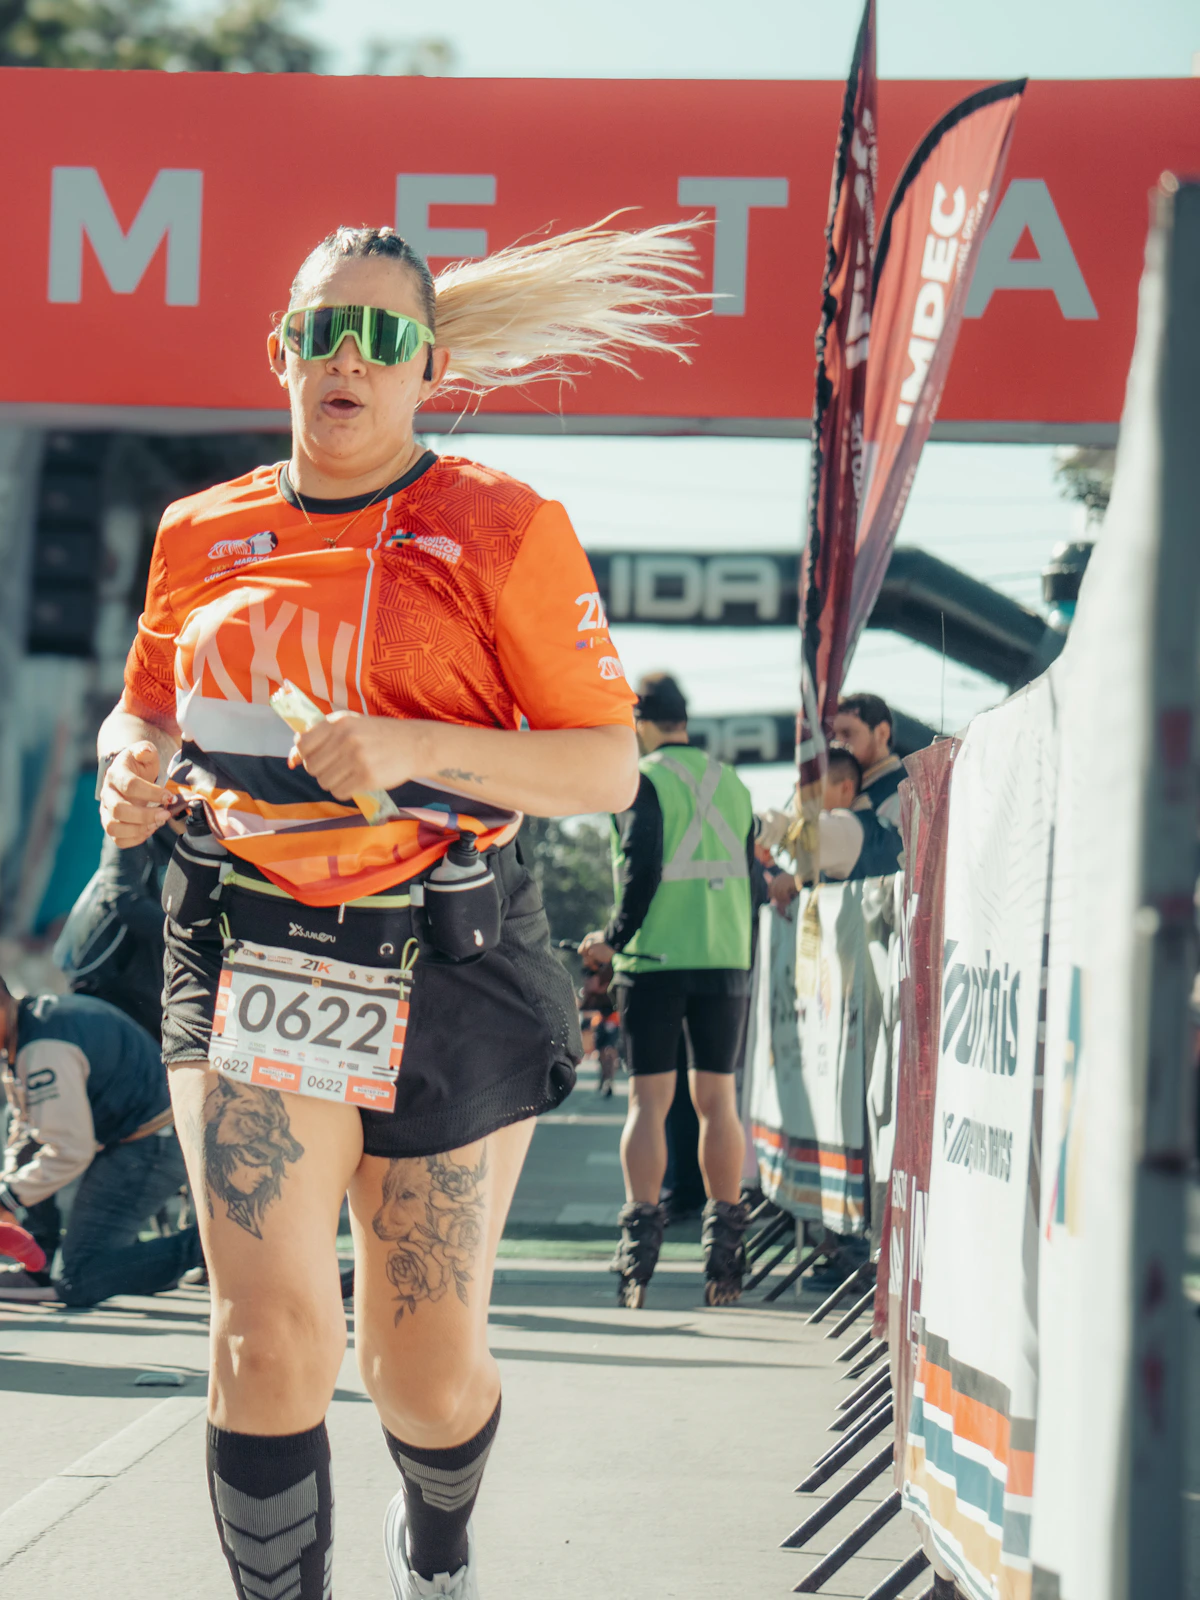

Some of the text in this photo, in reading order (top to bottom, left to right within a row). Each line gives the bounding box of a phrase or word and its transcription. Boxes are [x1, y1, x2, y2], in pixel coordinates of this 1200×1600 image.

[47, 166, 1099, 321] META
[896, 181, 966, 426] IMDEC
[608, 555, 780, 620] IDA
[300, 958, 334, 975] 21K
[238, 983, 388, 1056] 0622
[212, 1055, 250, 1075] 0622
[306, 1074, 344, 1094] 0622
